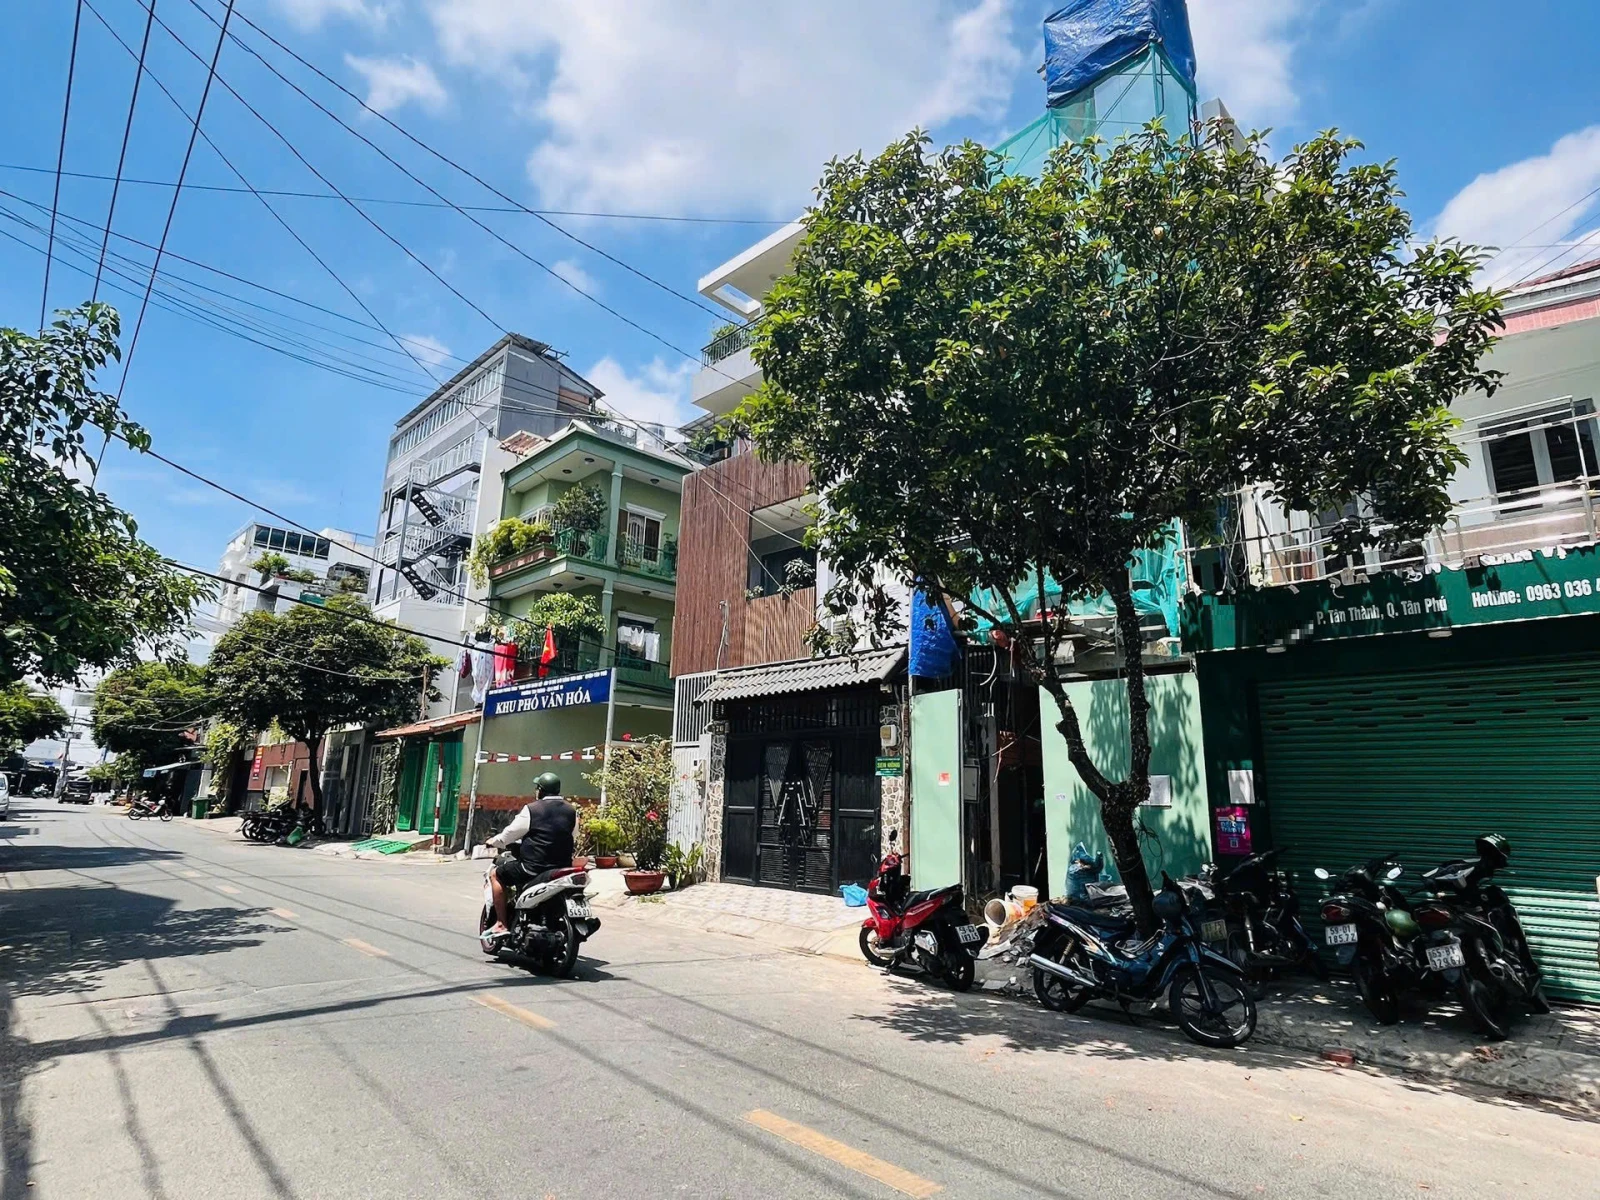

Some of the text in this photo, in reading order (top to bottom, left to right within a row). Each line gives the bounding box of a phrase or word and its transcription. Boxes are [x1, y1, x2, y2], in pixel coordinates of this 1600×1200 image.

[1472, 590, 1521, 608] Hotline:
[1526, 583, 1562, 602] 0963
[1564, 579, 1592, 598] 036
[1328, 609, 1346, 623] Tân
[1386, 602, 1399, 619] Q.
[1401, 600, 1421, 615] Tân
[1424, 596, 1448, 613] Phú
[495, 700, 516, 715] KHU
[541, 692, 564, 708] VĂN
[565, 687, 591, 706] HÓA
